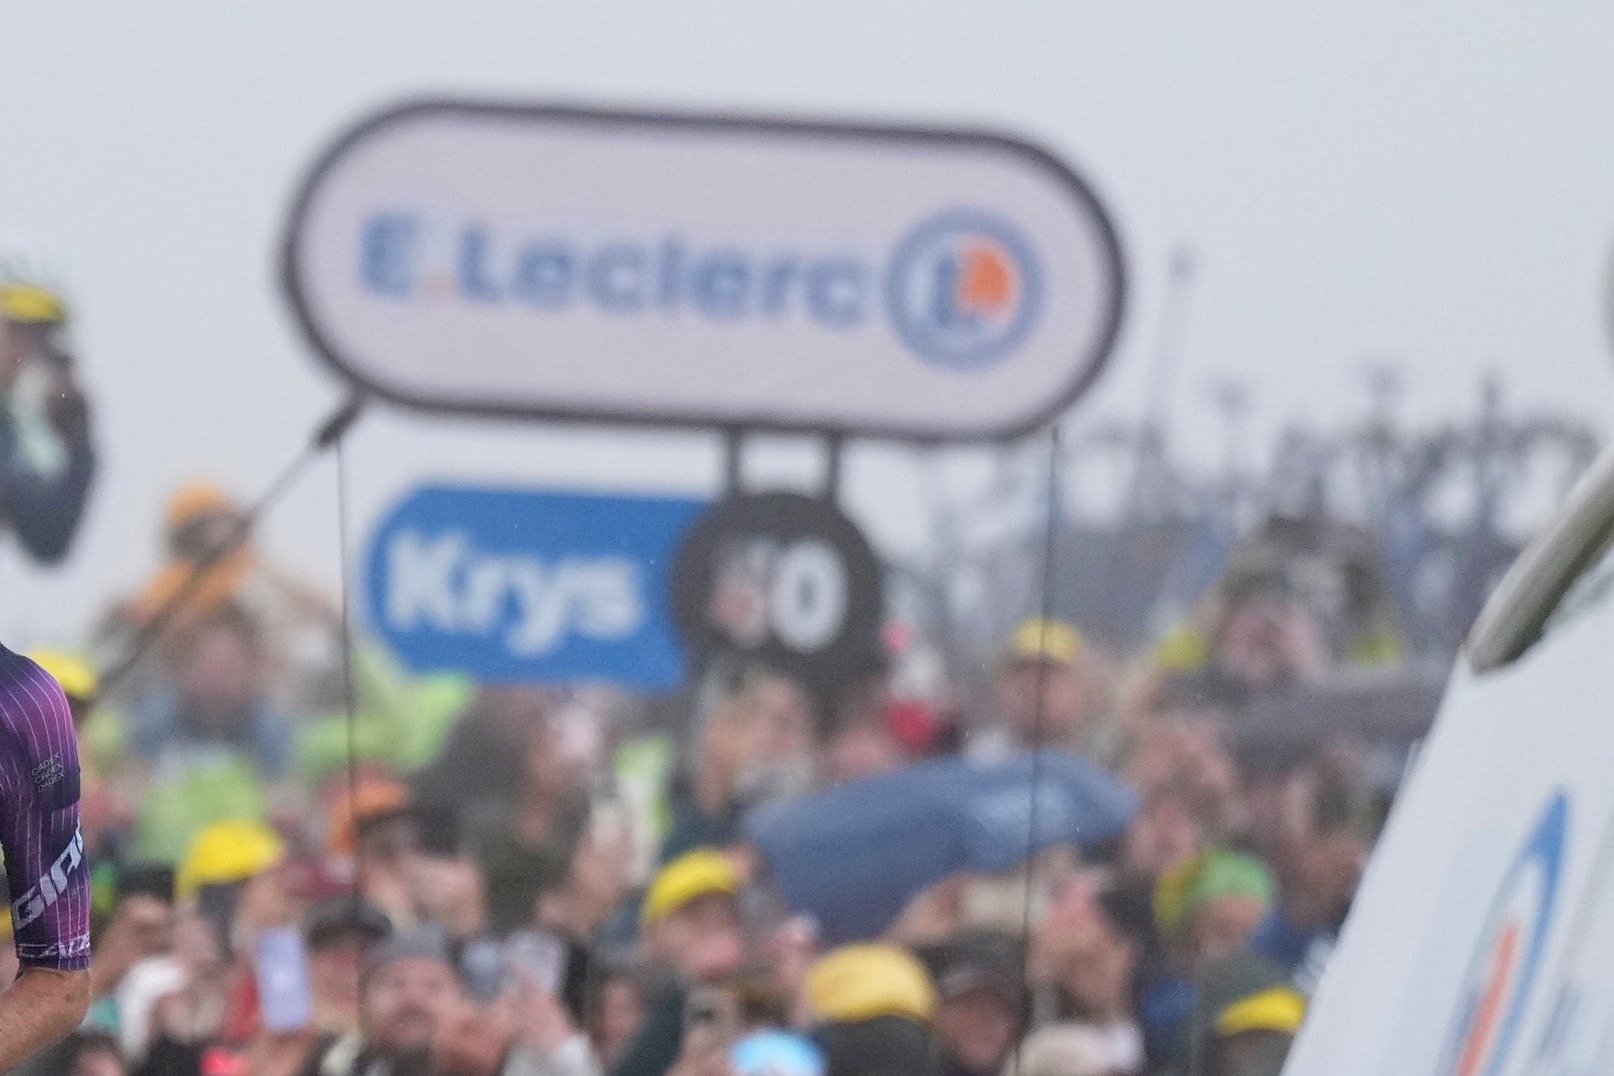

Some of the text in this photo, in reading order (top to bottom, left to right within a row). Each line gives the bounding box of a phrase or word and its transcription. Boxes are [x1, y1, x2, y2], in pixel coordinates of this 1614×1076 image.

[386, 527, 648, 657] Krys
[710, 540, 846, 650] 0
[11, 818, 84, 931] GIA
